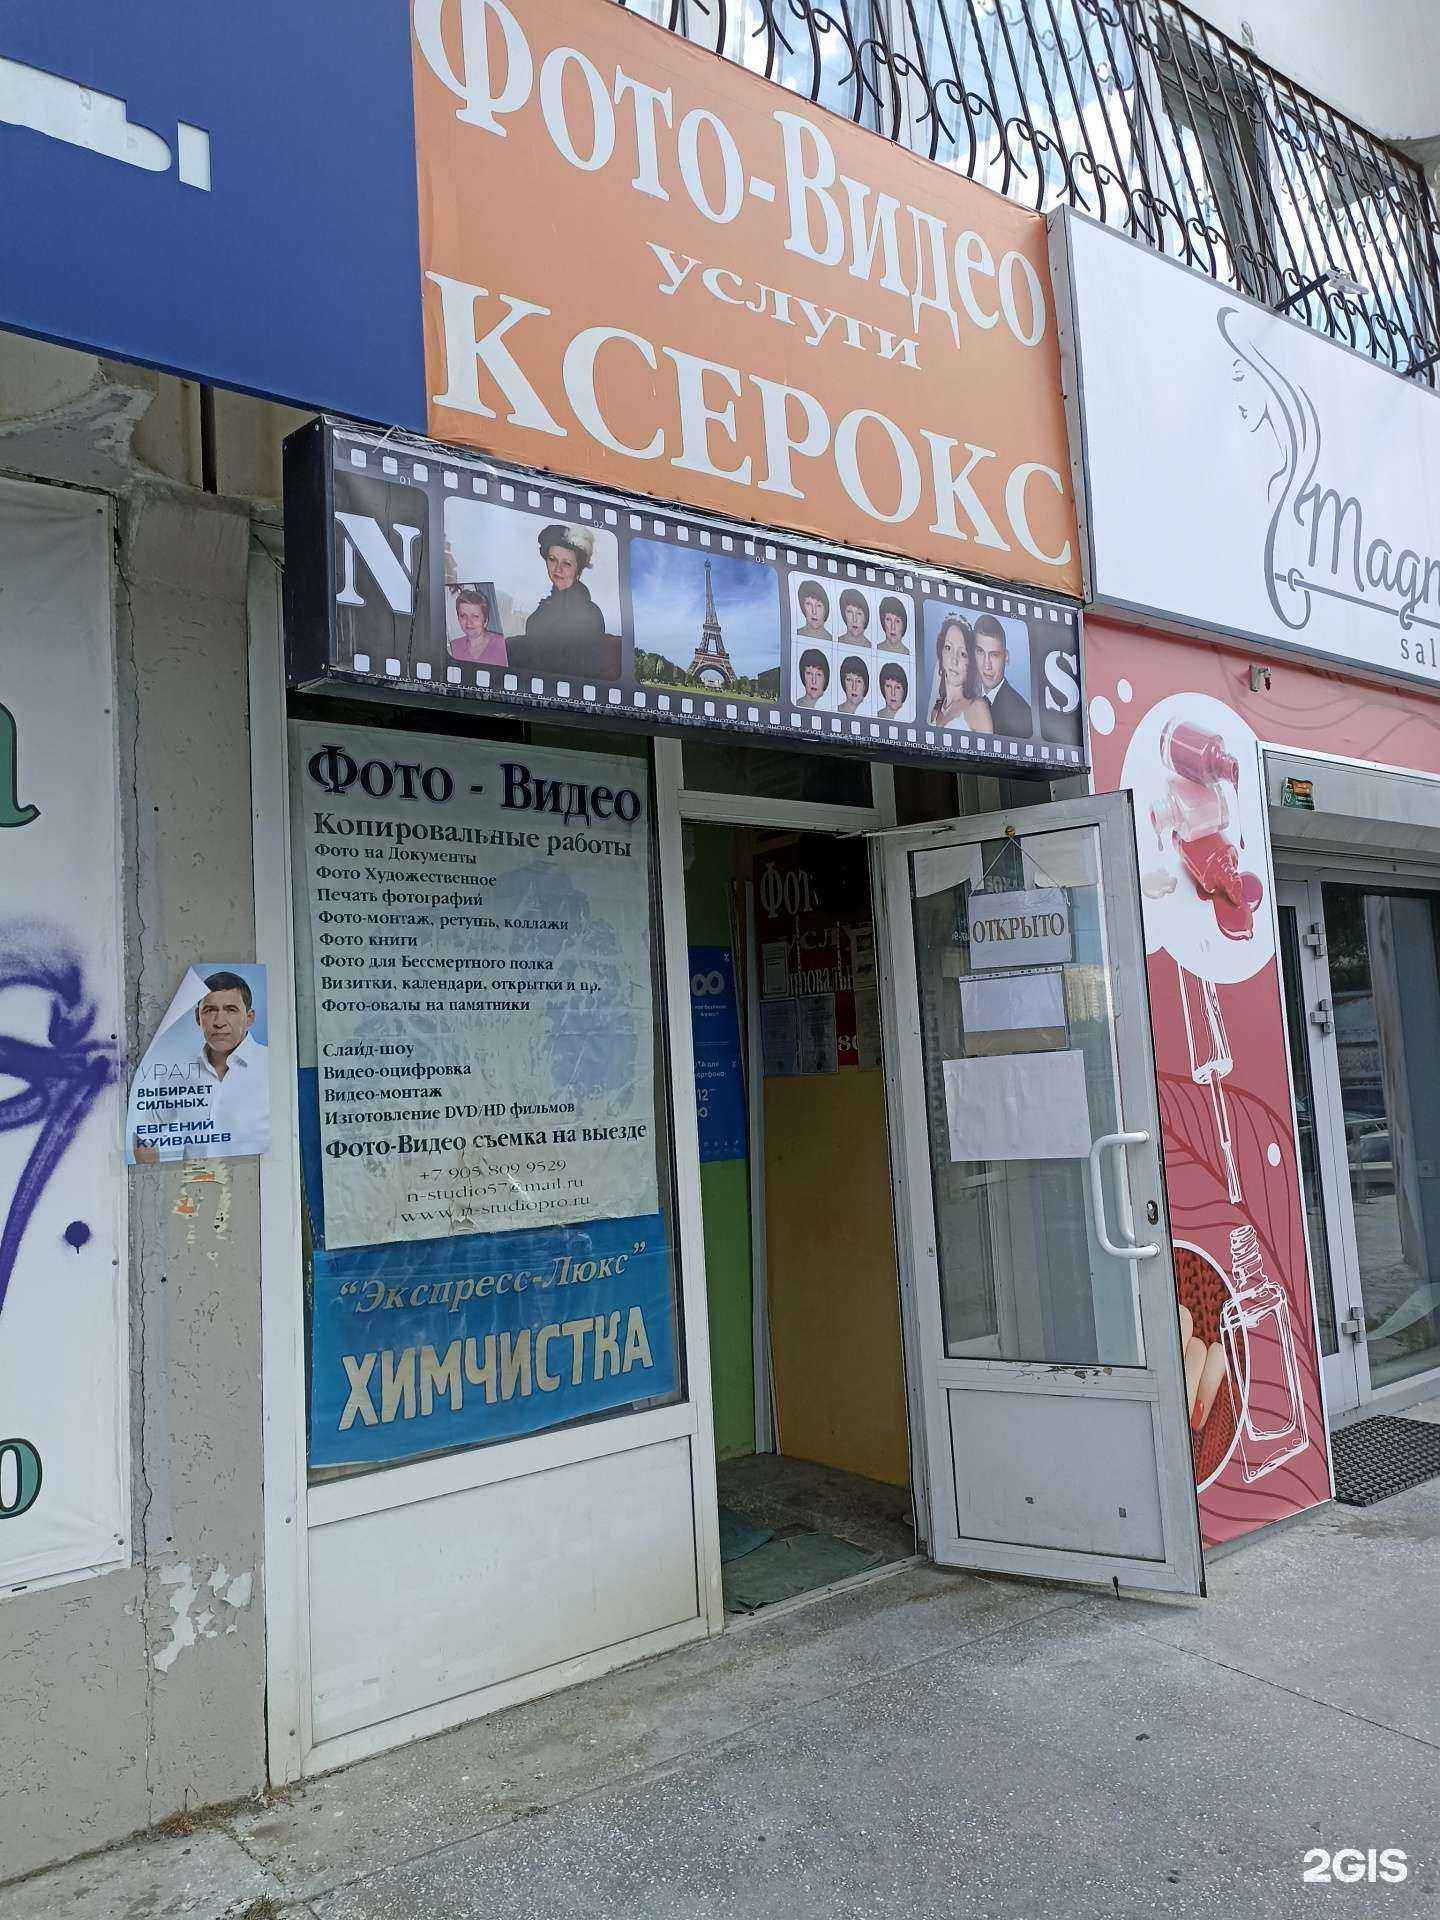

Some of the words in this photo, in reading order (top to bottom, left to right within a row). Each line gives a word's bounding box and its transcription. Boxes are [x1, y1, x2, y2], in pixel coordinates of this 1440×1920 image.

[413, 0, 1047, 348] Фото-Видео
[425, 270, 1072, 567] КСЕРОКС
[334, 511, 421, 614] N
[1044, 650, 1080, 713] S
[307, 744, 455, 803] Фото
[497, 761, 643, 828] Видео
[313, 812, 540, 849] Копировальные
[546, 831, 633, 858] работы
[314, 843, 360, 858] Фото
[364, 848, 384, 860] на
[387, 847, 478, 865] Документы
[315, 865, 361, 880] Фото
[365, 867, 498, 887] Художественное
[317, 887, 378, 903] Печать
[382, 888, 484, 909] фотографий
[318, 910, 435, 927] Фото-монтаж,
[504, 918, 569, 931] коллажи
[972, 912, 1065, 944] ОТКРЫТО
[319, 933, 363, 948] Фото
[368, 935, 418, 947] книги
[320, 954, 365, 969] Фото
[368, 957, 396, 970] для
[401, 955, 506, 972] Бессмертного
[509, 959, 554, 971] полка
[321, 976, 398, 992] Визитки,
[491, 979, 563, 994] открытки
[565, 980, 575, 992] и
[321, 999, 421, 1014] Фото-овалы
[425, 1000, 445, 1012] на
[449, 1000, 530, 1012] памятники
[322, 1040, 416, 1059] Слайд-шоу
[323, 1063, 472, 1081] Видео-оцифровка
[137, 1084, 213, 1098] ВЫБИРАЕТ
[324, 1086, 443, 1103] Видео-монтаж
[325, 1107, 441, 1125] Изготовление
[445, 1103, 507, 1120] DVD/HD
[510, 1100, 576, 1118] фильмов
[136, 1118, 215, 1135] ЕВГЕНИЙ
[136, 1132, 232, 1148] КУЙВАШЕВ
[325, 1131, 467, 1159] Фото-Видео
[472, 1126, 547, 1149] съемка
[552, 1127, 577, 1144] на
[582, 1122, 647, 1142] выезде
[337, 1305, 655, 1432] ХИМЧИСТКА
